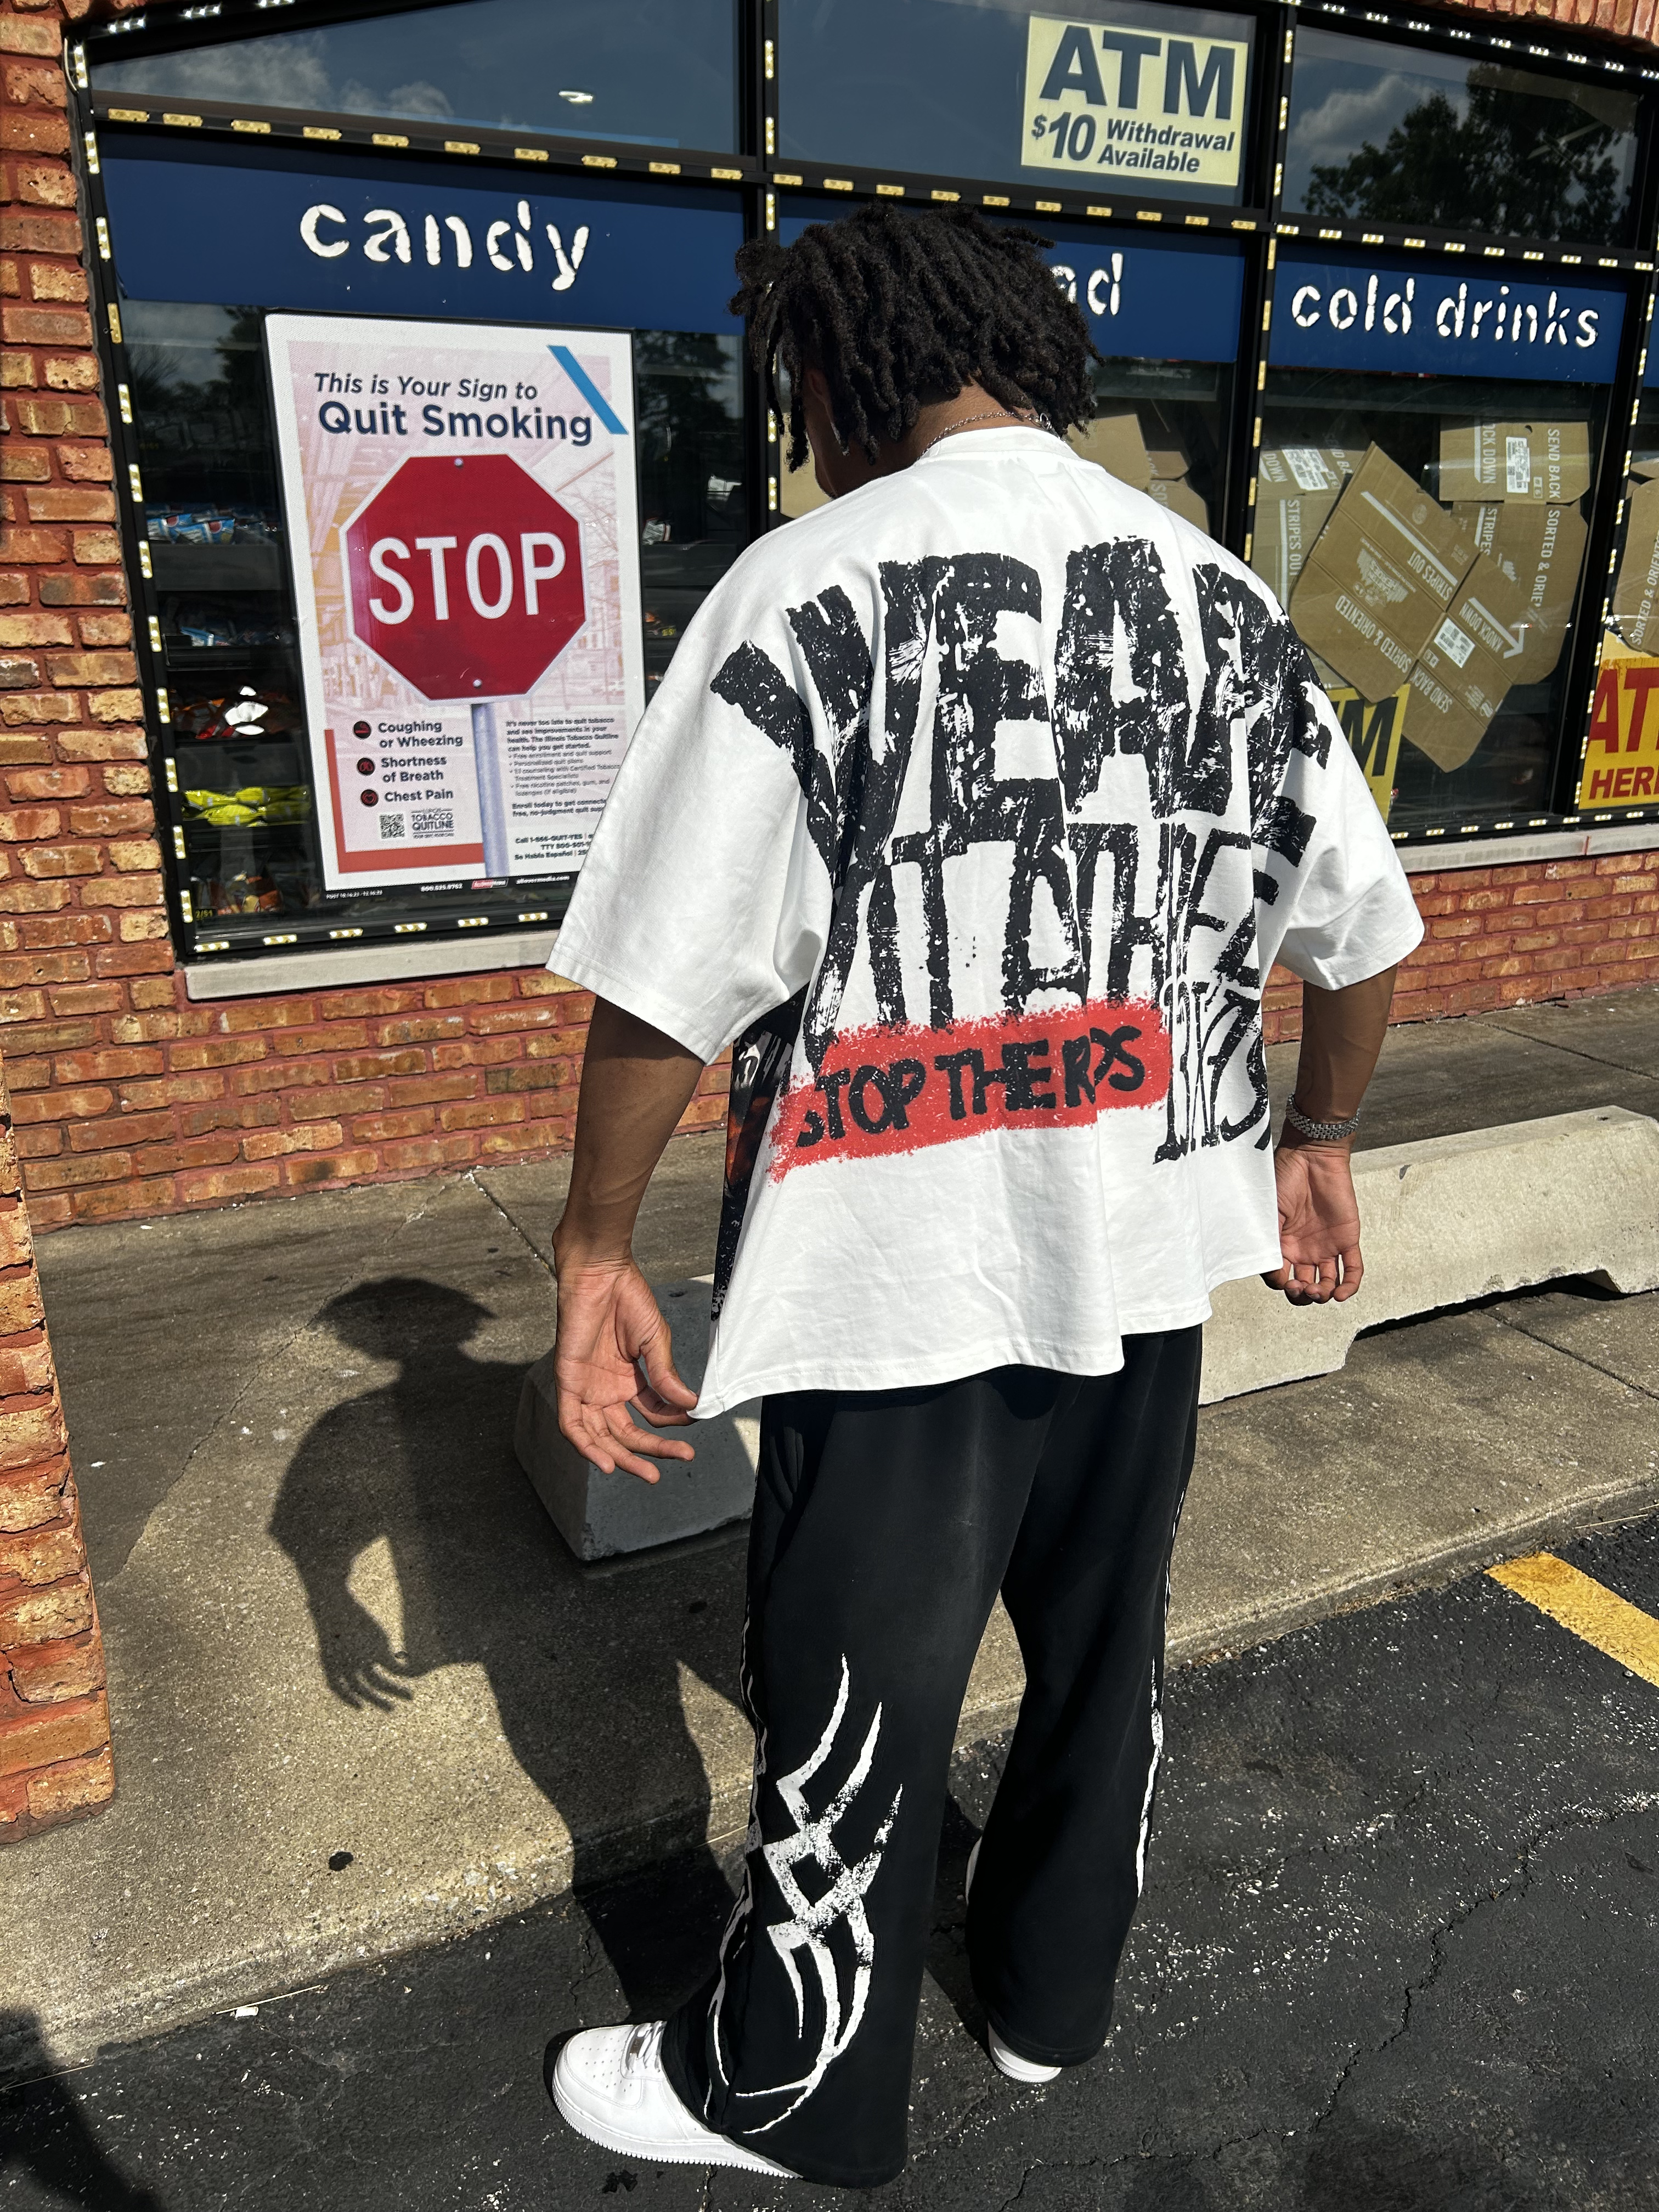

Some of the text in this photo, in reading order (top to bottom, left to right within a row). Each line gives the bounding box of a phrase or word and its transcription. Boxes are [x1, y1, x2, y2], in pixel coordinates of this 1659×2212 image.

[1040, 25, 1235, 120] ATM
[1031, 112, 1096, 161] $10
[1107, 119, 1235, 151] Withdrawal
[1098, 144, 1200, 173] Available
[300, 200, 589, 291] candy
[1293, 274, 1598, 348] cold drinks
[314, 373, 538, 402] This is Your Sign to
[318, 400, 592, 446] Quit Smoking
[1262, 453, 1288, 483] DOWN
[1483, 424, 1496, 484] OCK DOWN
[1548, 429, 1561, 499] SEND BACK
[1288, 499, 1301, 550] STRIPES
[1480, 508, 1498, 556] STRIPES
[1541, 510, 1560, 558] SORTED
[369, 532, 566, 625] STOP
[1407, 550, 1453, 601] STRIPES OUT
[1538, 562, 1550, 571] &
[1531, 575, 1547, 607] ORIE
[1335, 595, 1375, 640] ORIENTED
[1458, 602, 1504, 653] KNOCK DOWN
[1632, 600, 1652, 646] SORTED
[1373, 632, 1384, 647] &
[1380, 636, 1412, 674] SORTED
[1409, 667, 1435, 697] BACK
[1430, 692, 1453, 714] SEND
[1587, 667, 1659, 754] AT
[378, 720, 443, 734] Coughing
[379, 734, 464, 748] or Wheezing
[381, 756, 447, 768] Shortness
[382, 770, 444, 783] of Breath
[384, 788, 454, 802] Chest Pain
[1589, 766, 1659, 800] HER
[411, 812, 453, 822] TOBACCO
[412, 820, 454, 831] QUITLINE
